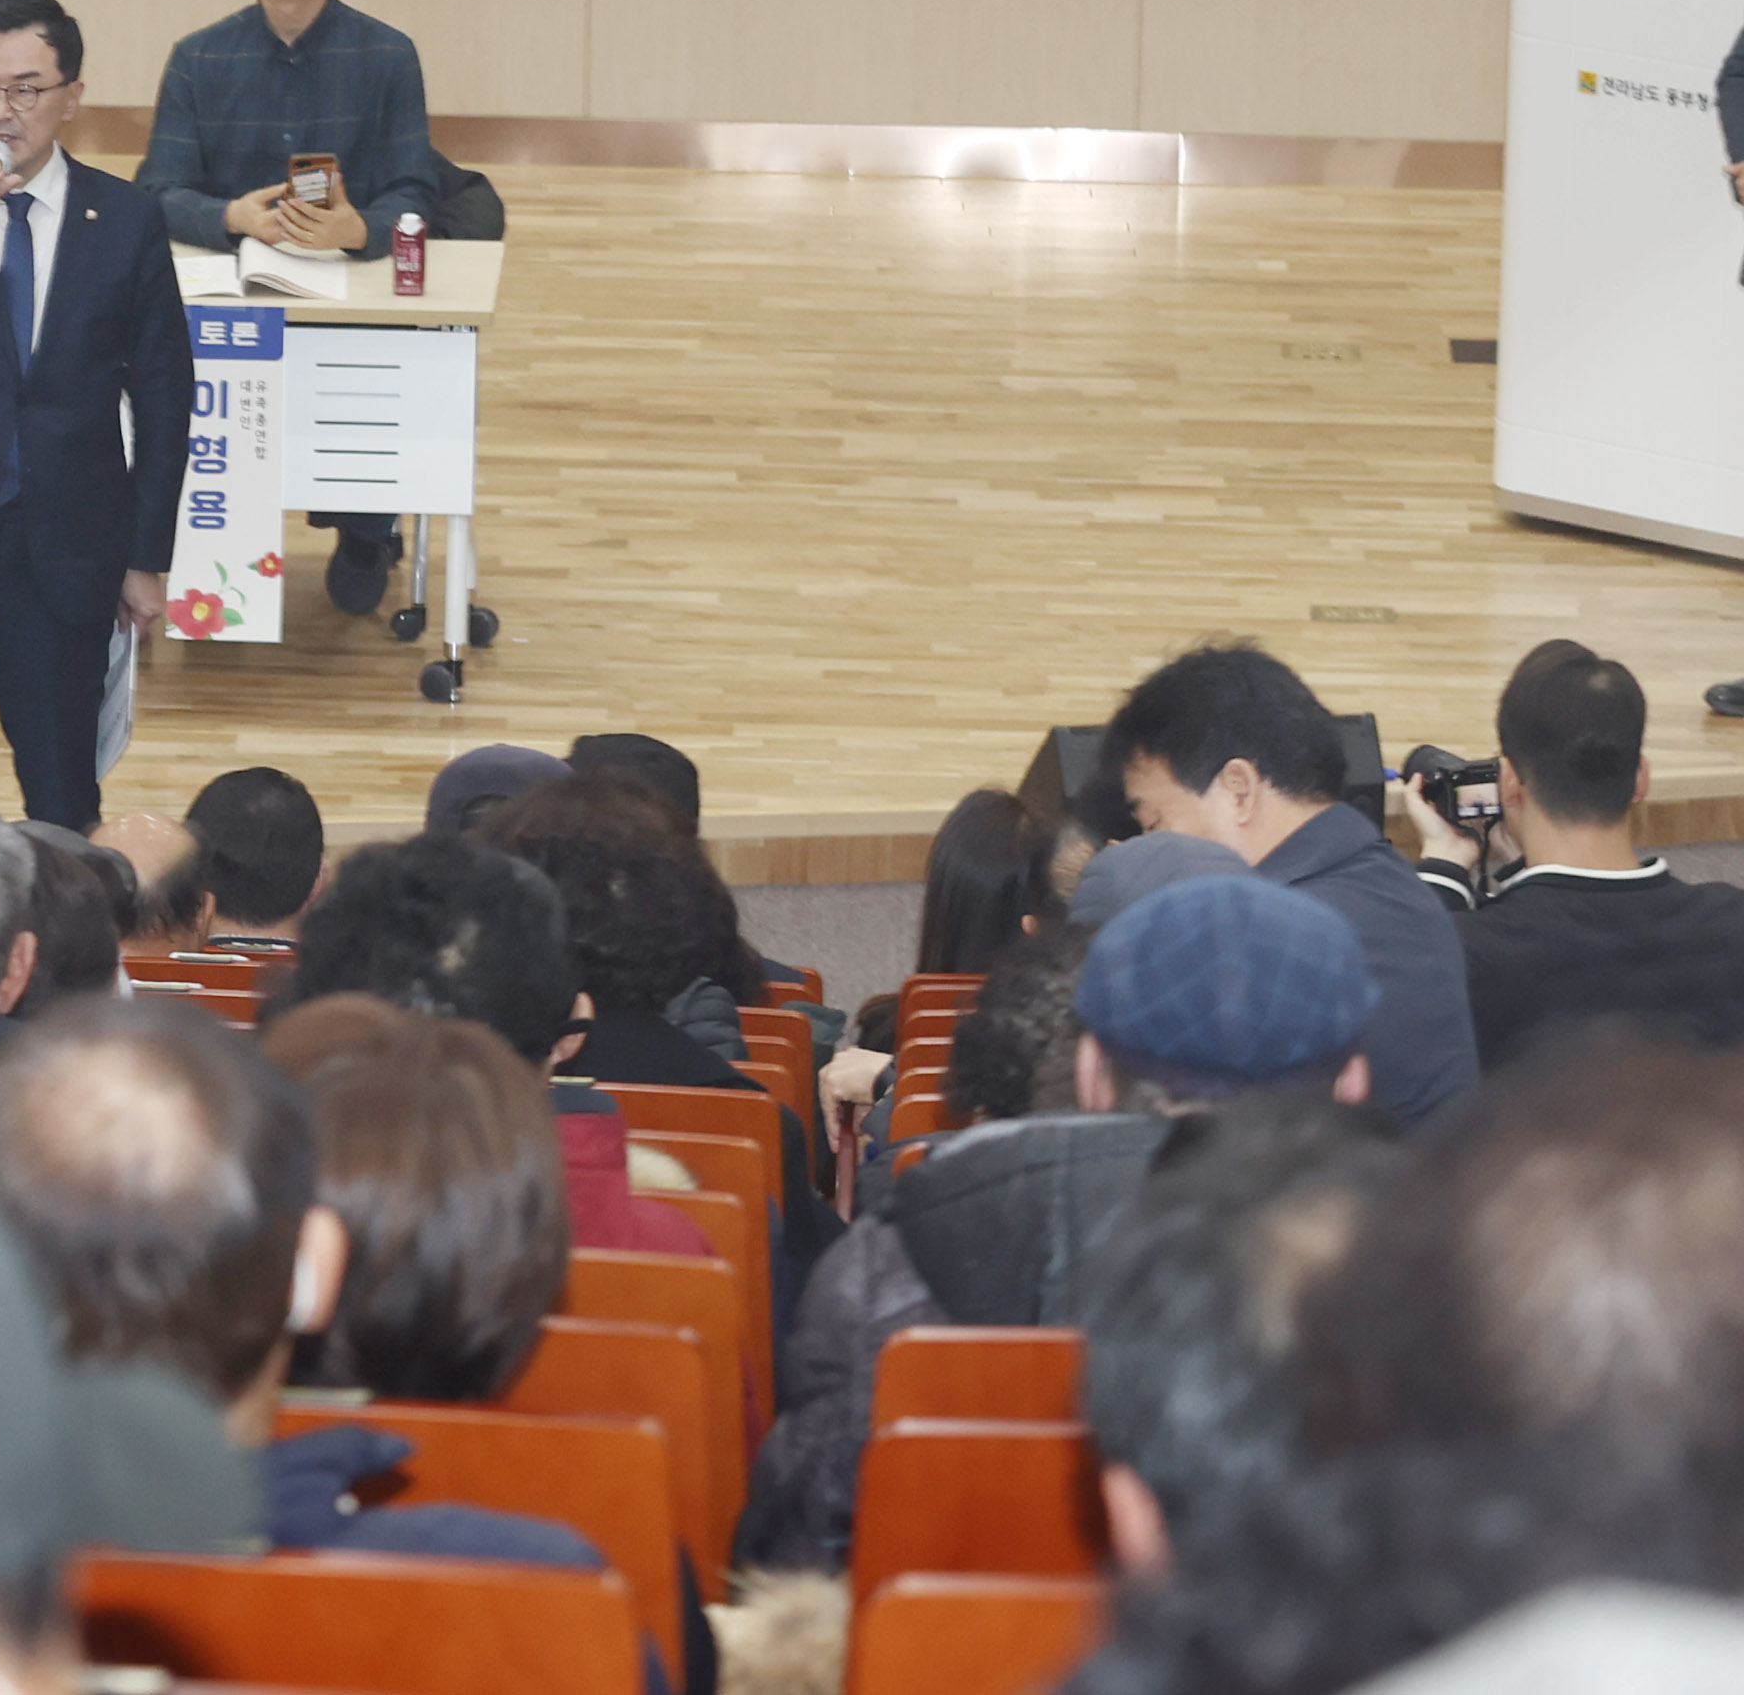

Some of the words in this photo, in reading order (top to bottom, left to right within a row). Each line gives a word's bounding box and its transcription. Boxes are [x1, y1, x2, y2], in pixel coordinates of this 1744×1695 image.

[1603, 76, 1661, 102] 전라남도
[1667, 87, 1718, 112] 동부청
[198, 320, 260, 347] 토론
[188, 379, 229, 531] 이형용
